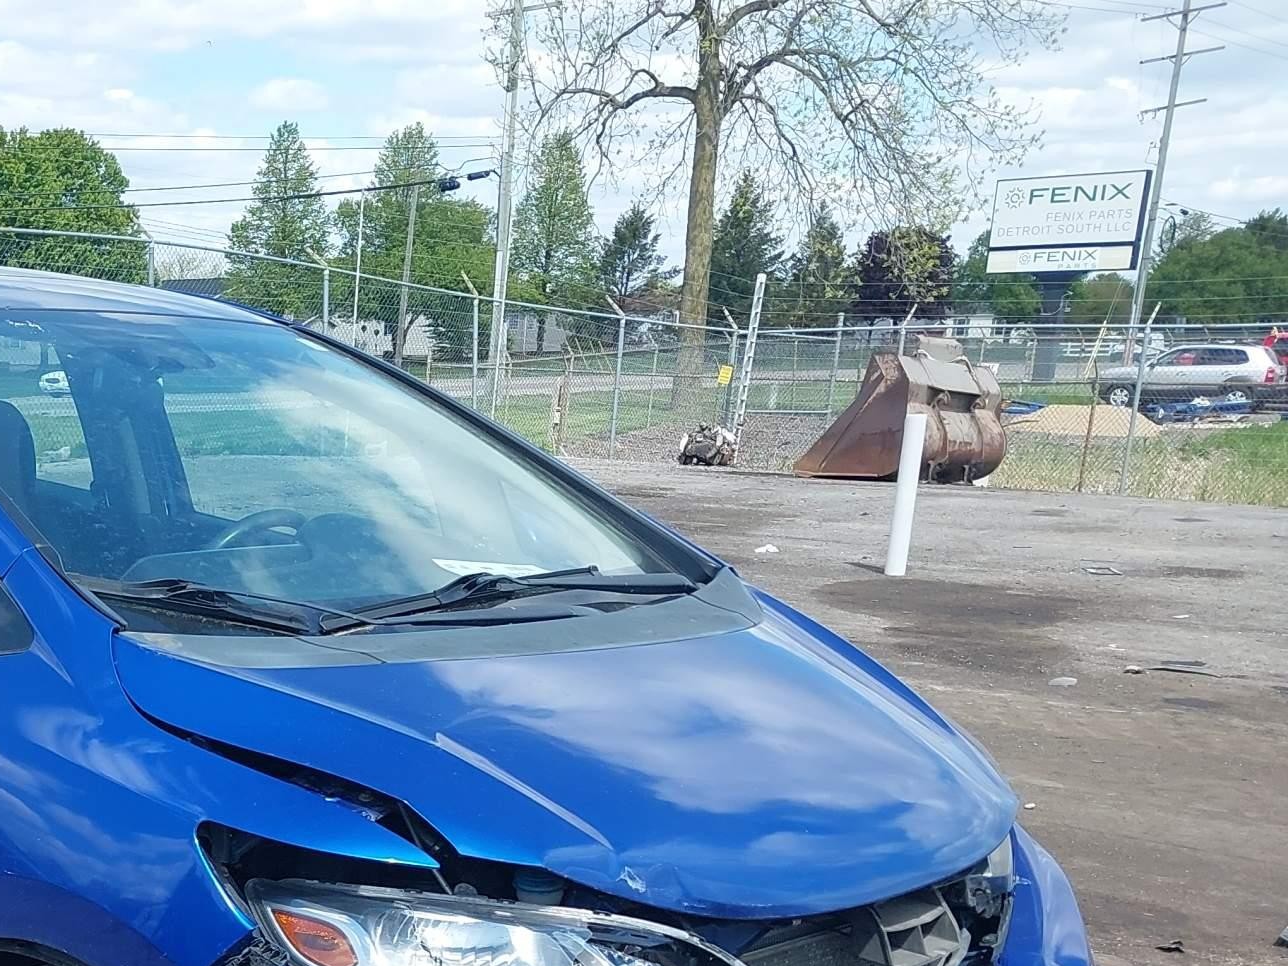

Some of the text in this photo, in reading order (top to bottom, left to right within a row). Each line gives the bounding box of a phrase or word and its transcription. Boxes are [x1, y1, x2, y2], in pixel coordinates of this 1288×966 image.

[1029, 183, 1133, 204] FENIX
[1046, 208, 1133, 222] FENIX PARTS
[997, 221, 1131, 238] DETROIT SOUTH LLC
[1033, 249, 1098, 263] FENIX
